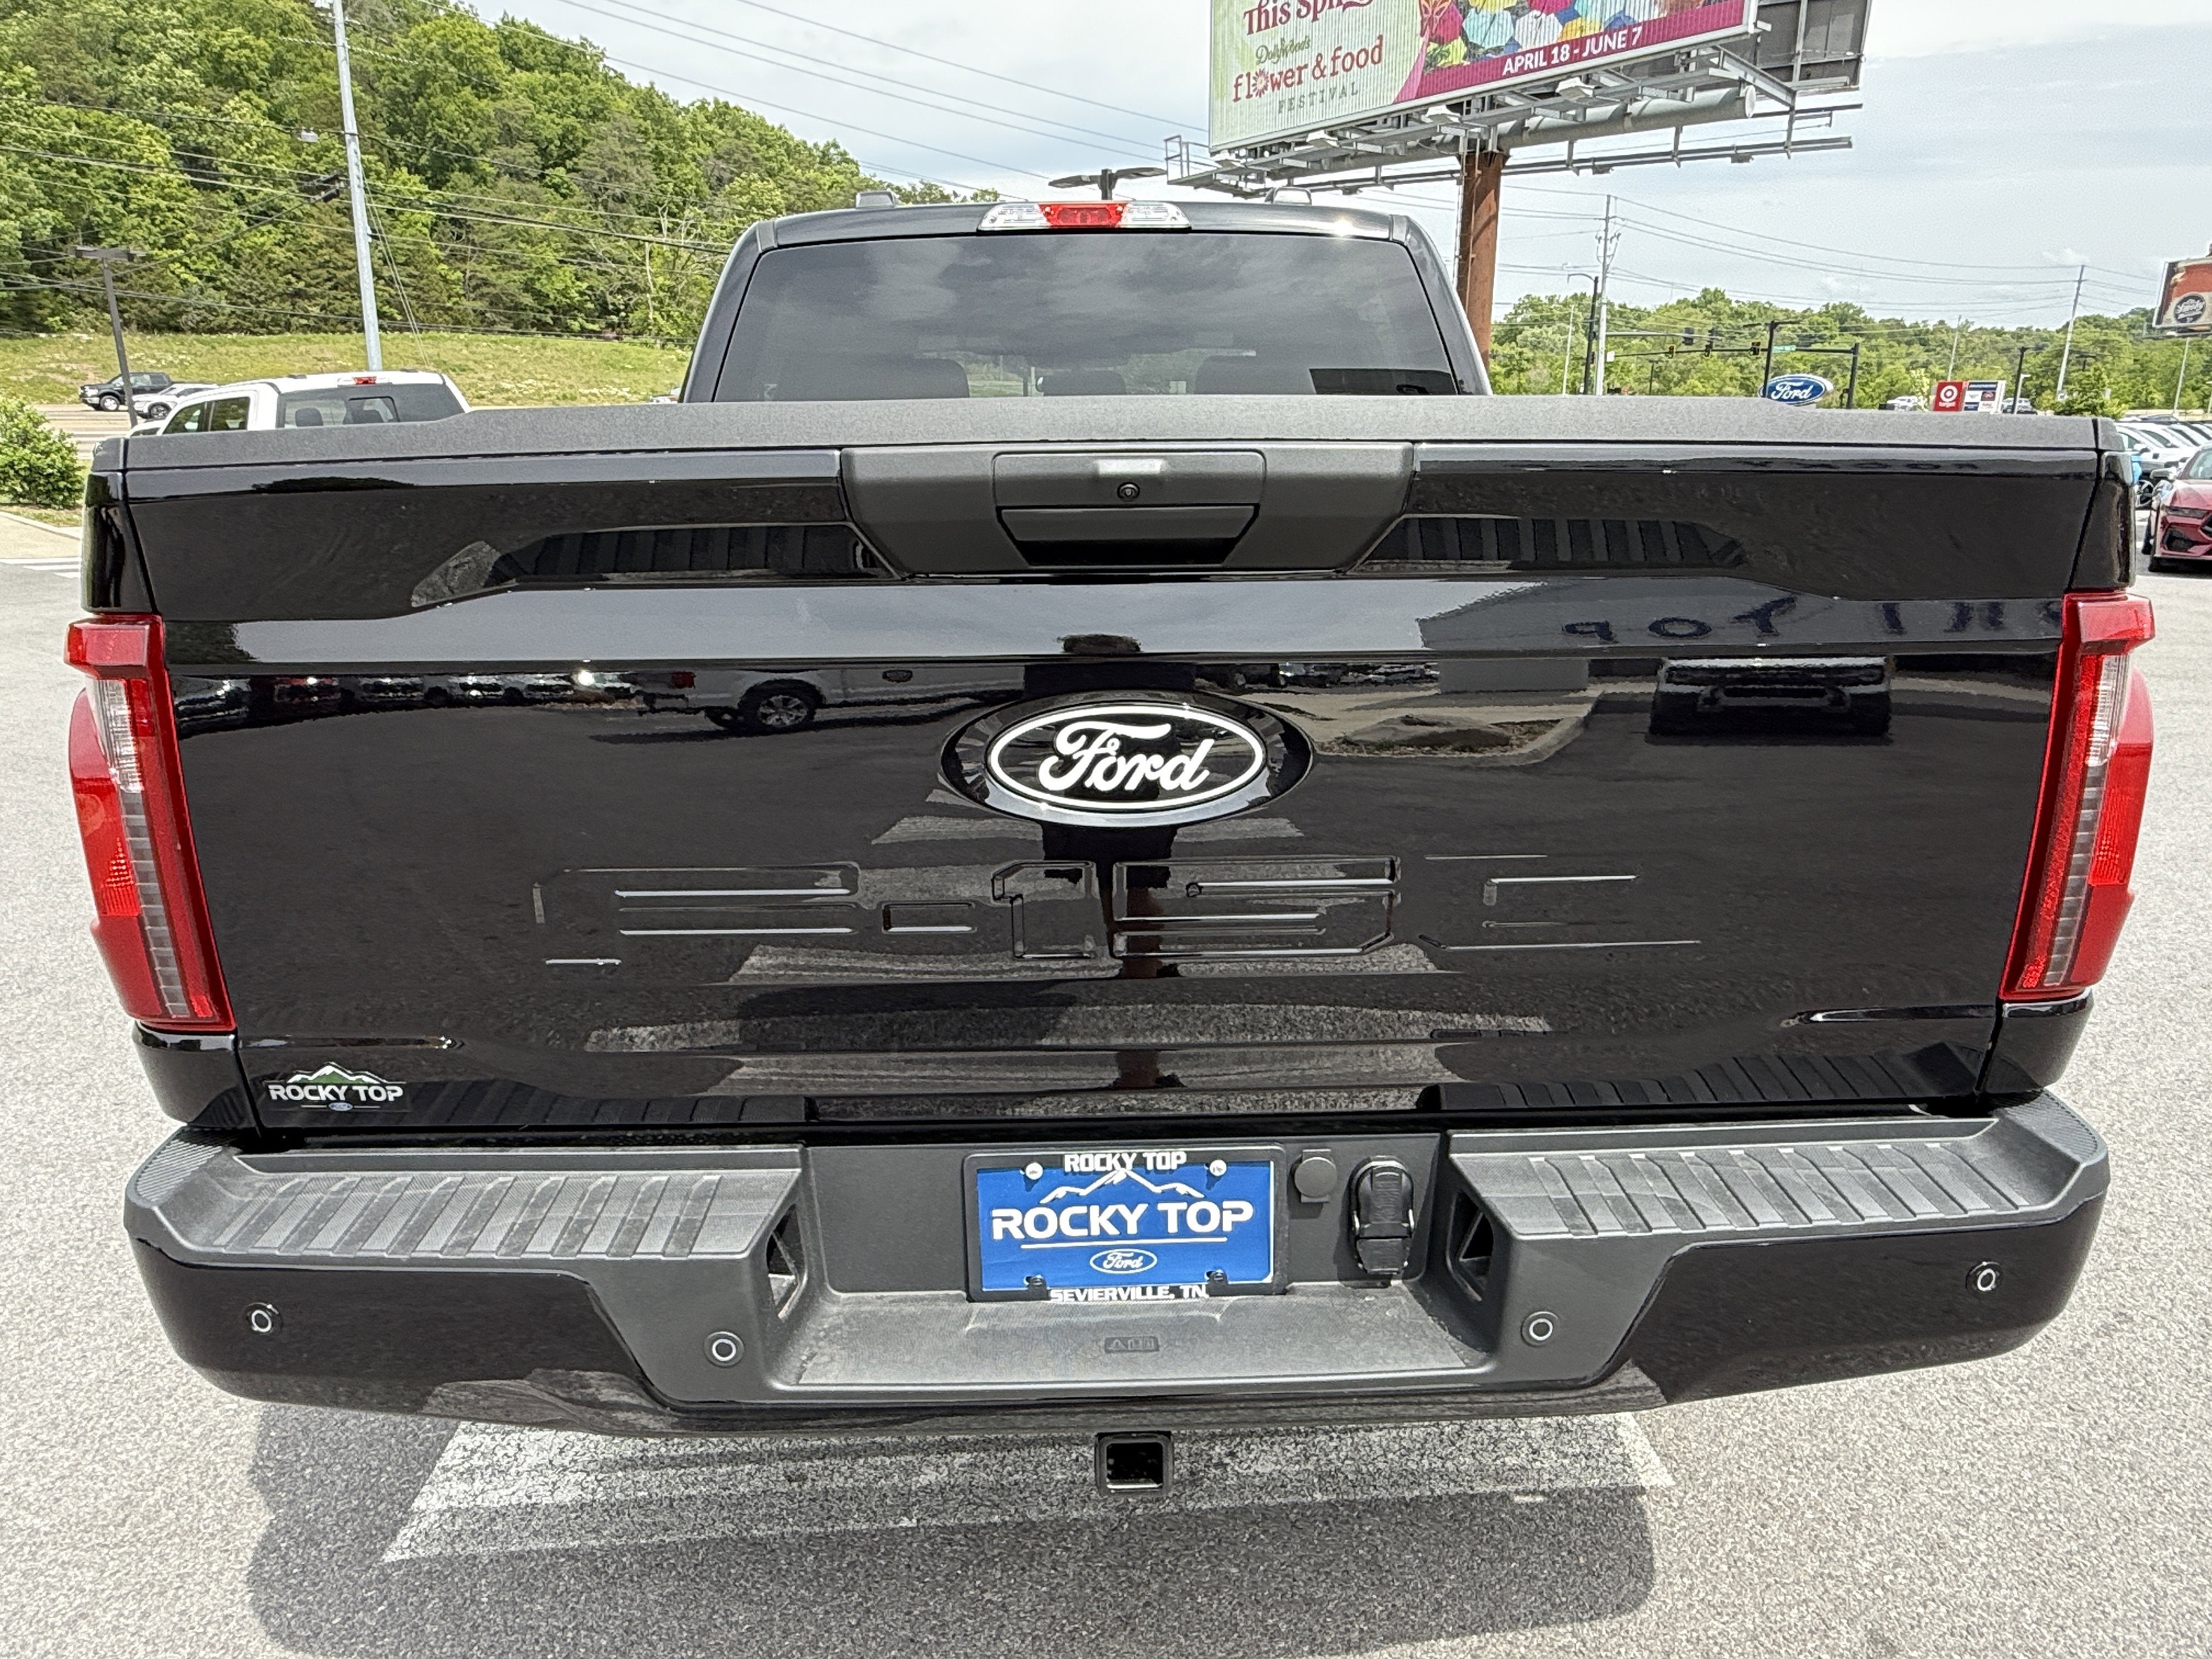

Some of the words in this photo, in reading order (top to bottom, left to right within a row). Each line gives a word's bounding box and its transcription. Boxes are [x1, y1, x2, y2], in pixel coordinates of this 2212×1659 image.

[1243, 0, 1291, 36] This
[1312, 53, 1327, 80] &
[1330, 34, 1384, 77] food
[1502, 50, 1547, 76] APRIL
[1551, 44, 1570, 65] 18
[1583, 30, 1628, 57] JUNE
[1632, 26, 1643, 46] 7
[1278, 82, 1358, 114] FESTIVAL
[1771, 382, 1814, 399] Ford
[1038, 721, 1216, 791] Ford
[268, 1085, 348, 1101] ROCKY
[352, 1086, 404, 1102] TOP
[1064, 1153, 1137, 1172] ROCKY
[1143, 1152, 1187, 1170] TOP
[991, 1204, 1149, 1240] ROCKY
[1157, 1200, 1254, 1233] TOP
[1102, 1251, 1143, 1268] Ford
